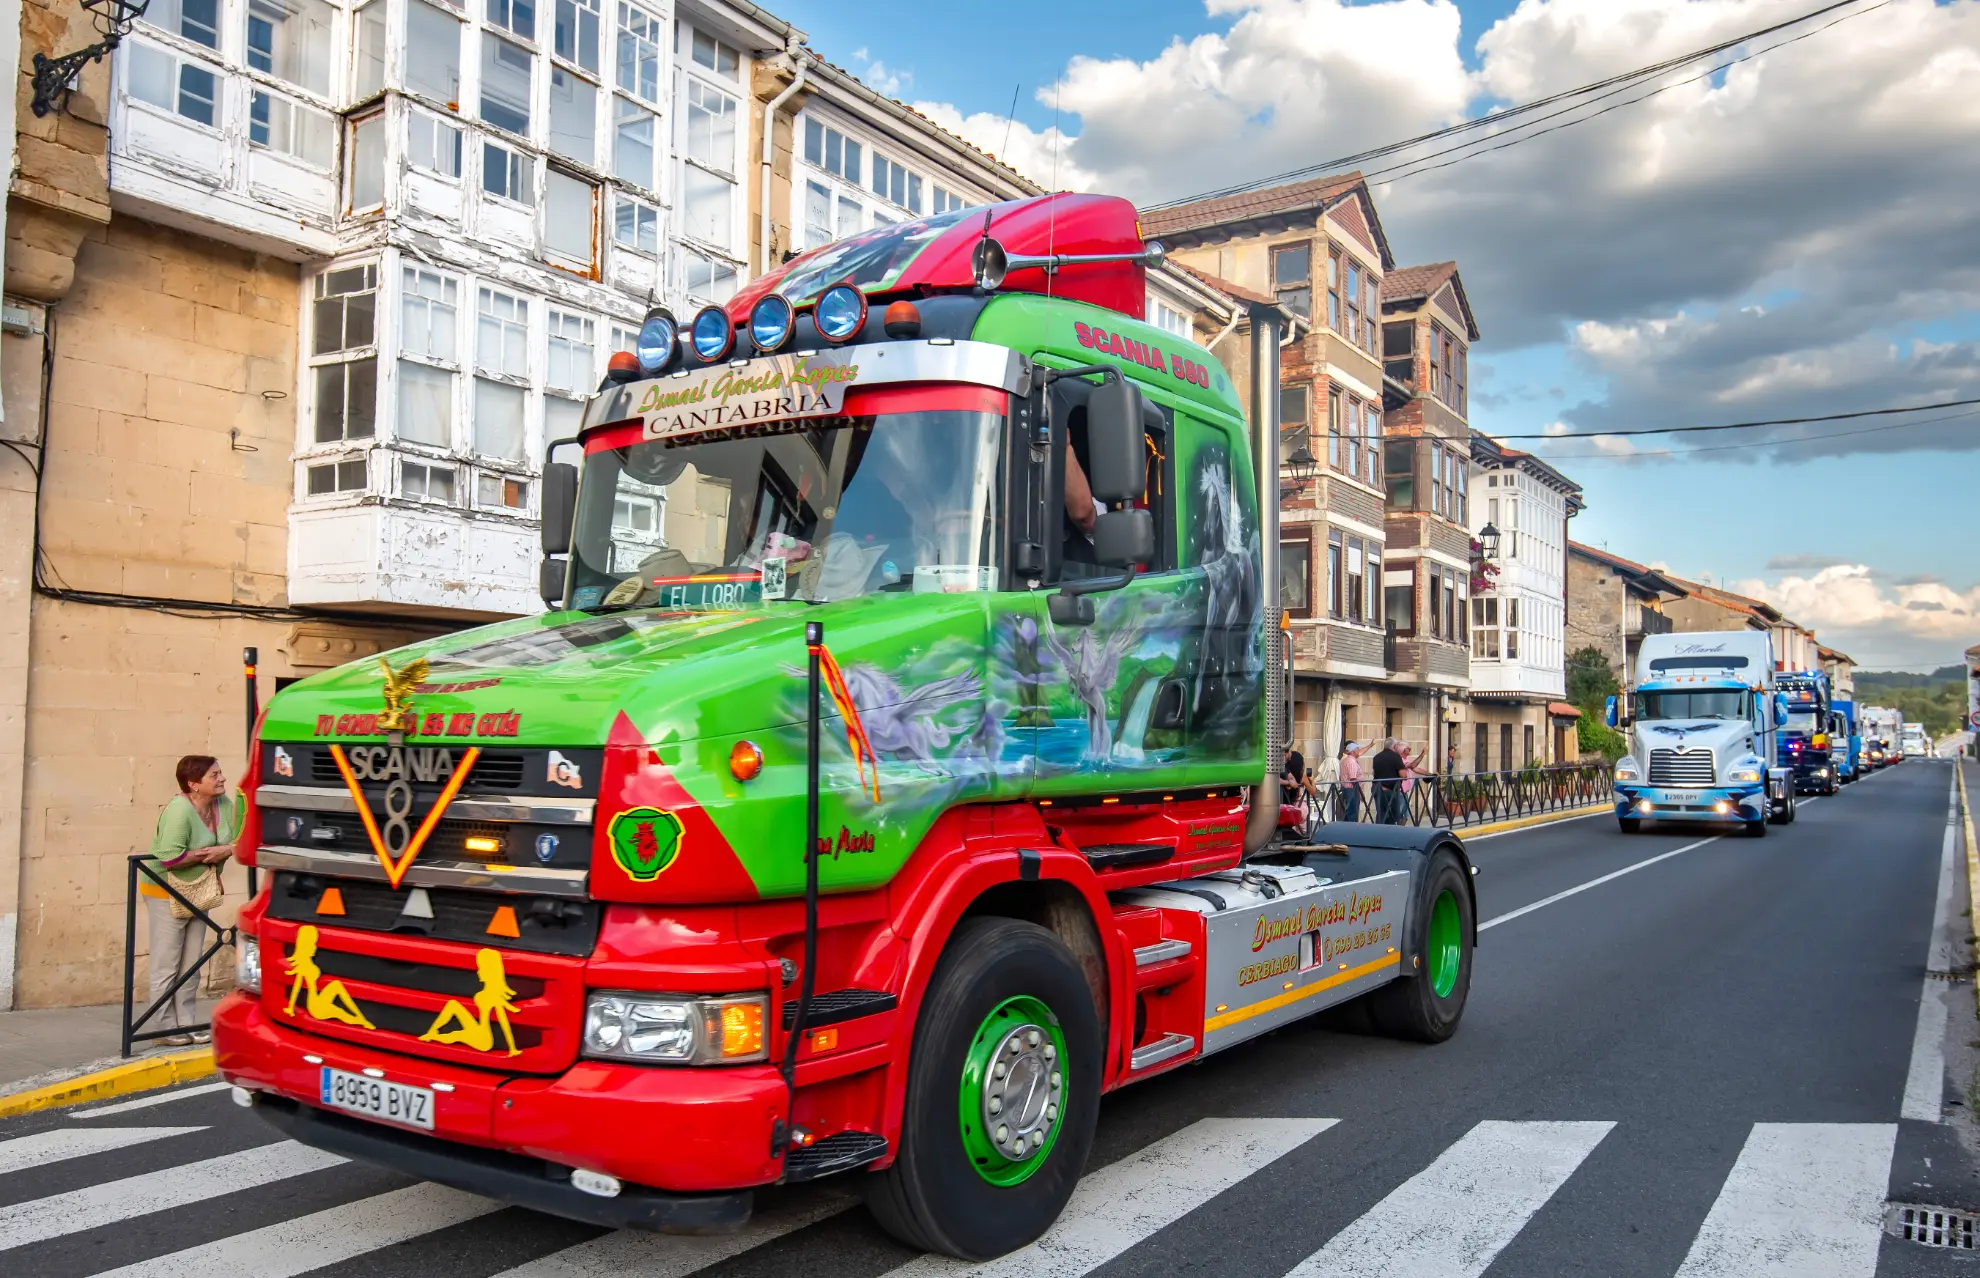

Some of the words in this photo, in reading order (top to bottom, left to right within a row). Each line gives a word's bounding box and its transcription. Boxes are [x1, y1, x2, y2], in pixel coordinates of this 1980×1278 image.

[1075, 321, 1168, 374] SCANIA
[1170, 353, 1210, 389] 580
[637, 379, 708, 414] Ismael
[711, 370, 783, 405] Garcia
[788, 358, 858, 395] Lopez
[649, 392, 834, 435] CANTABRIA
[670, 585, 691, 607] EL
[701, 583, 745, 605] LOBO
[350, 746, 455, 782] SCANIA
[1251, 907, 1303, 952] Ismael
[1306, 902, 1345, 931] Garcia
[1237, 953, 1298, 987] CERBIAGO
[335, 1074, 381, 1111] 8959
[388, 1086, 427, 1122] BVZ
